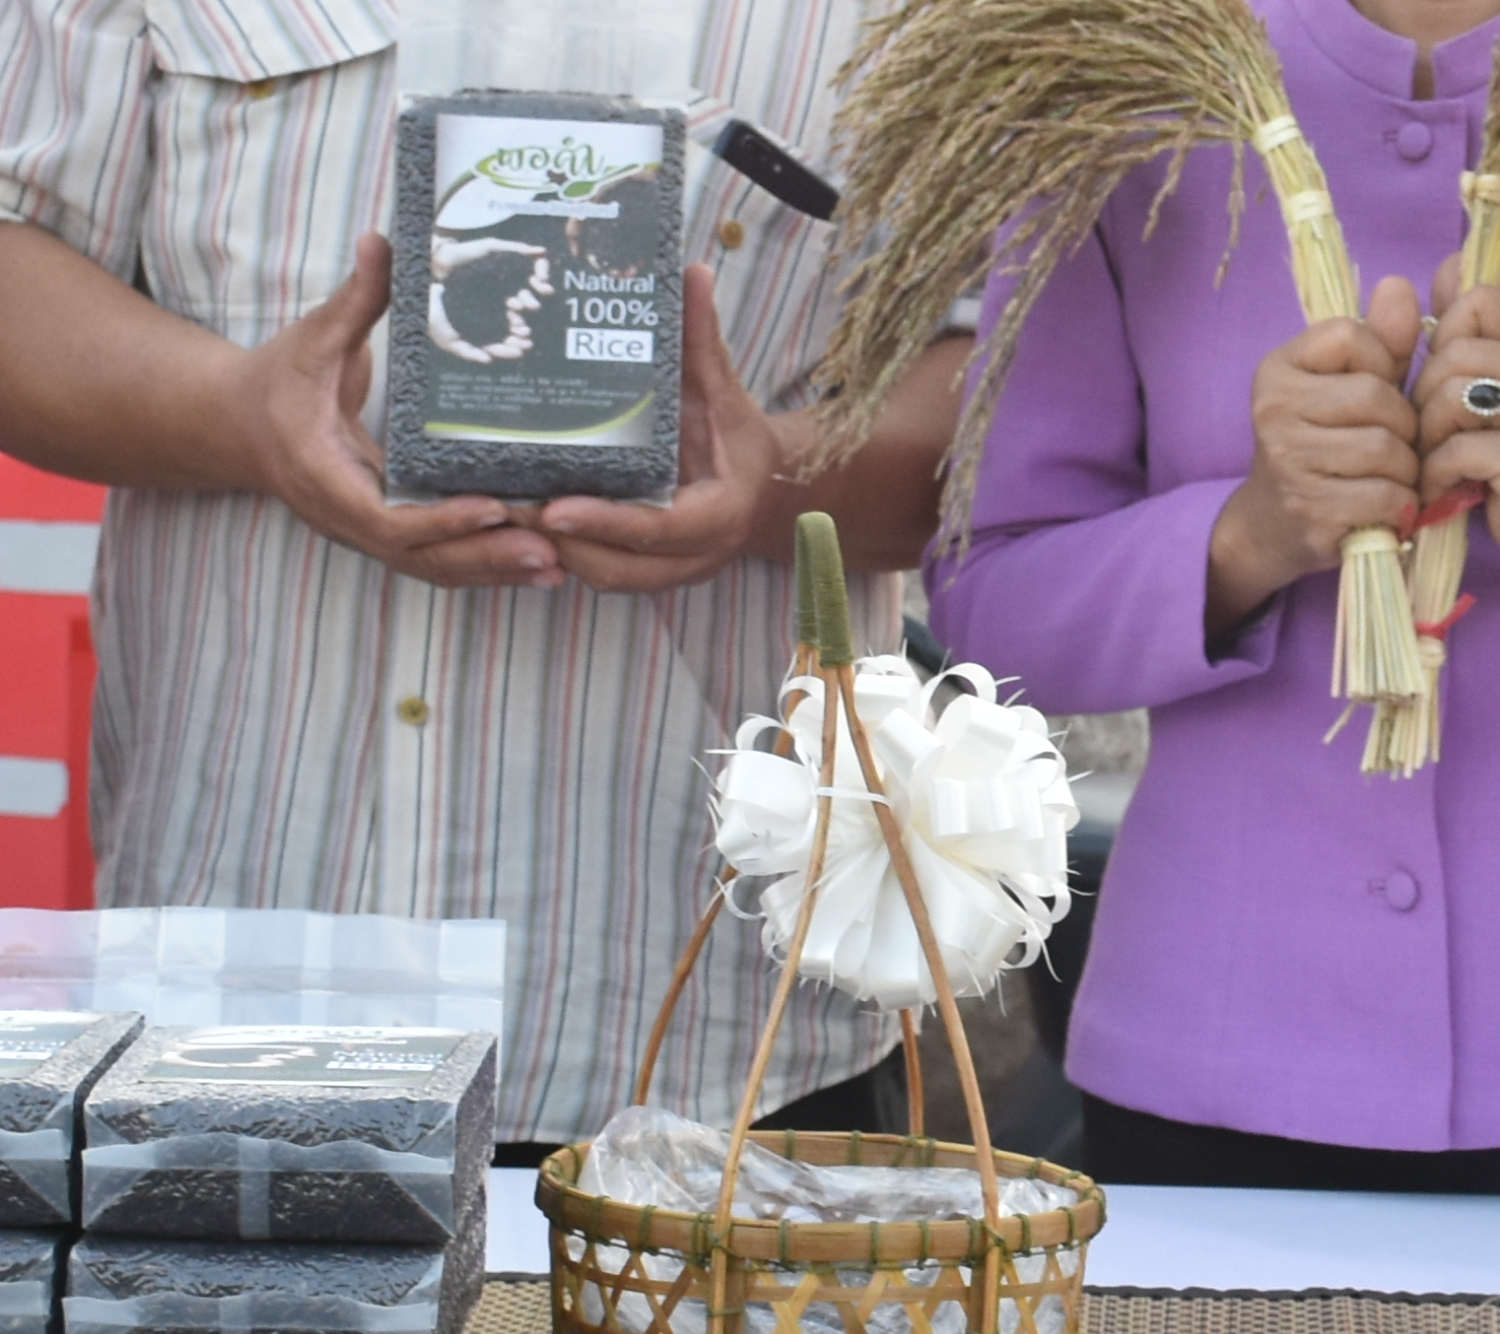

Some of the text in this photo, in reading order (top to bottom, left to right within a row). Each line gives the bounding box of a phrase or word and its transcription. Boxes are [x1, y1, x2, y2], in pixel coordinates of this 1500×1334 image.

[563, 269, 655, 294] Natural
[565, 296, 659, 327] 100%
[573, 331, 645, 359] Rice
